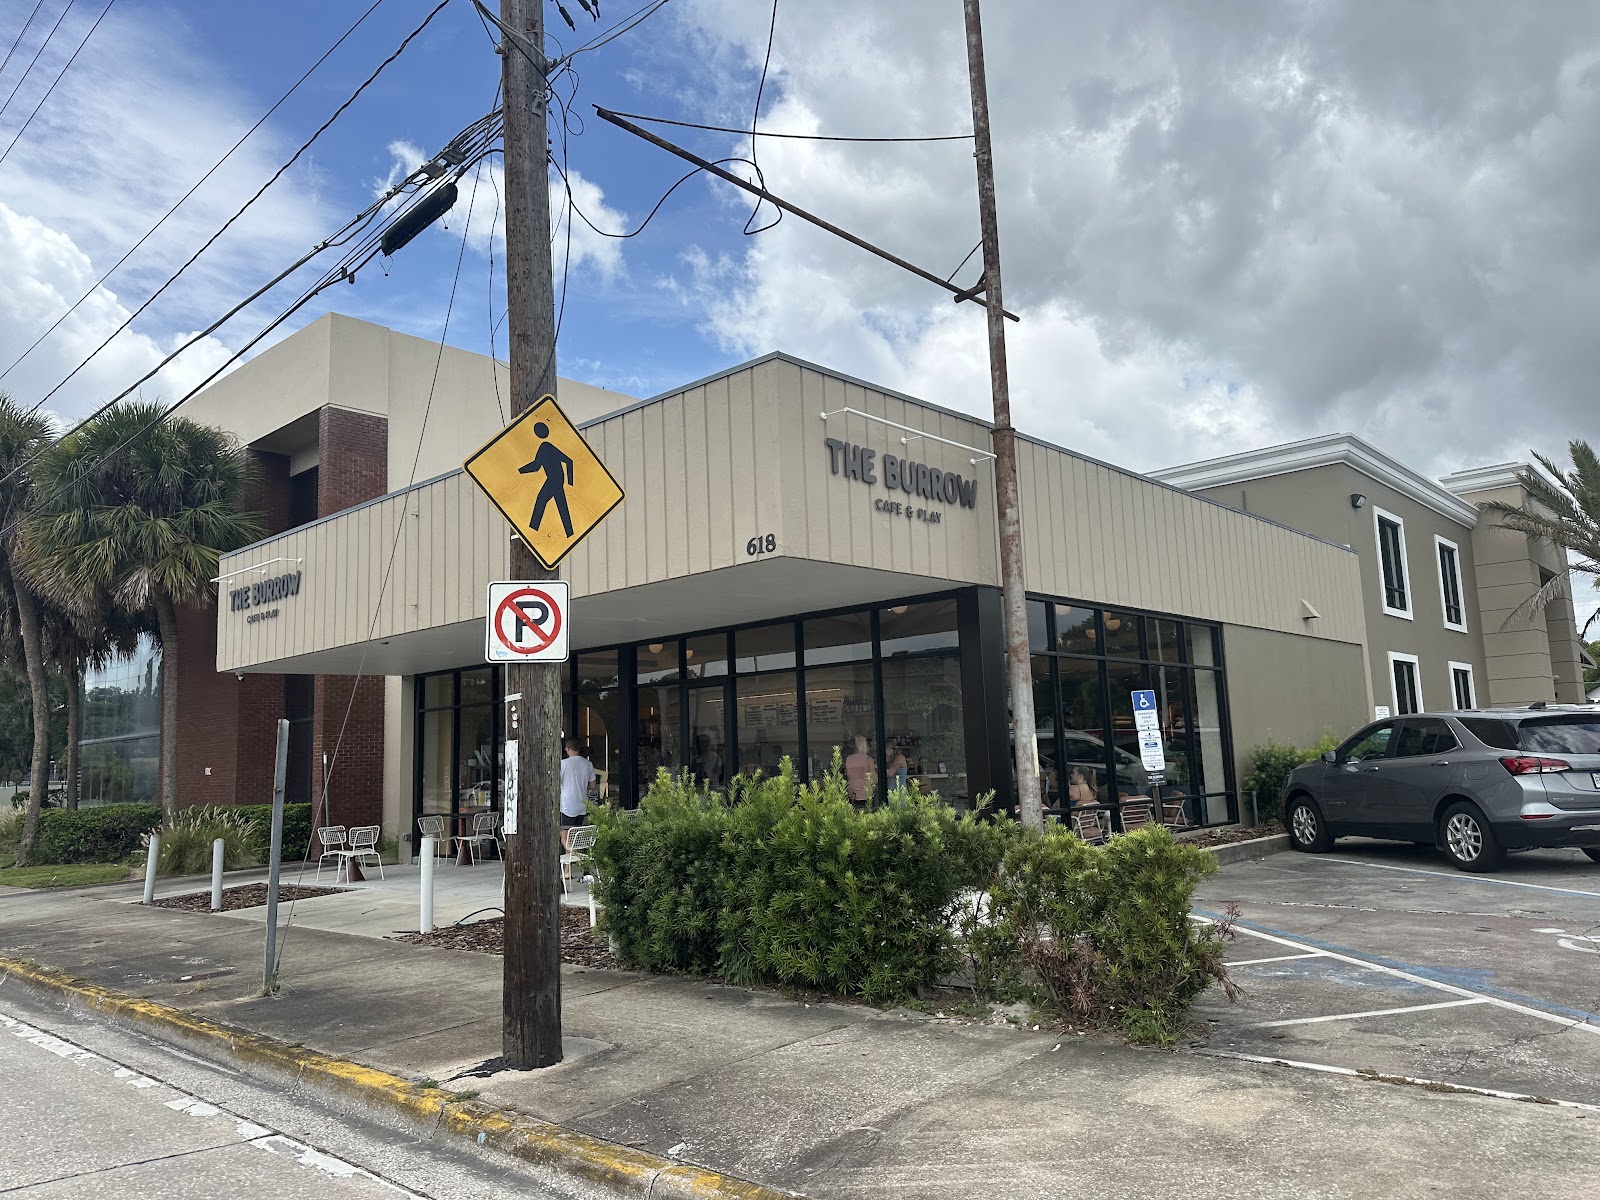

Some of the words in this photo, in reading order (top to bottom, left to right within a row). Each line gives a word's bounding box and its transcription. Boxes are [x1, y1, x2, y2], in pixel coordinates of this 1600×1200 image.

[826, 437, 877, 484] THE
[884, 453, 977, 509] BURROW
[875, 498, 902, 515] CAFE
[906, 505, 914, 518] &
[917, 507, 942, 523] PLAY
[747, 533, 776, 556] 618
[229, 585, 250, 612] THE
[252, 570, 301, 606] BURROW
[515, 601, 549, 642] P
